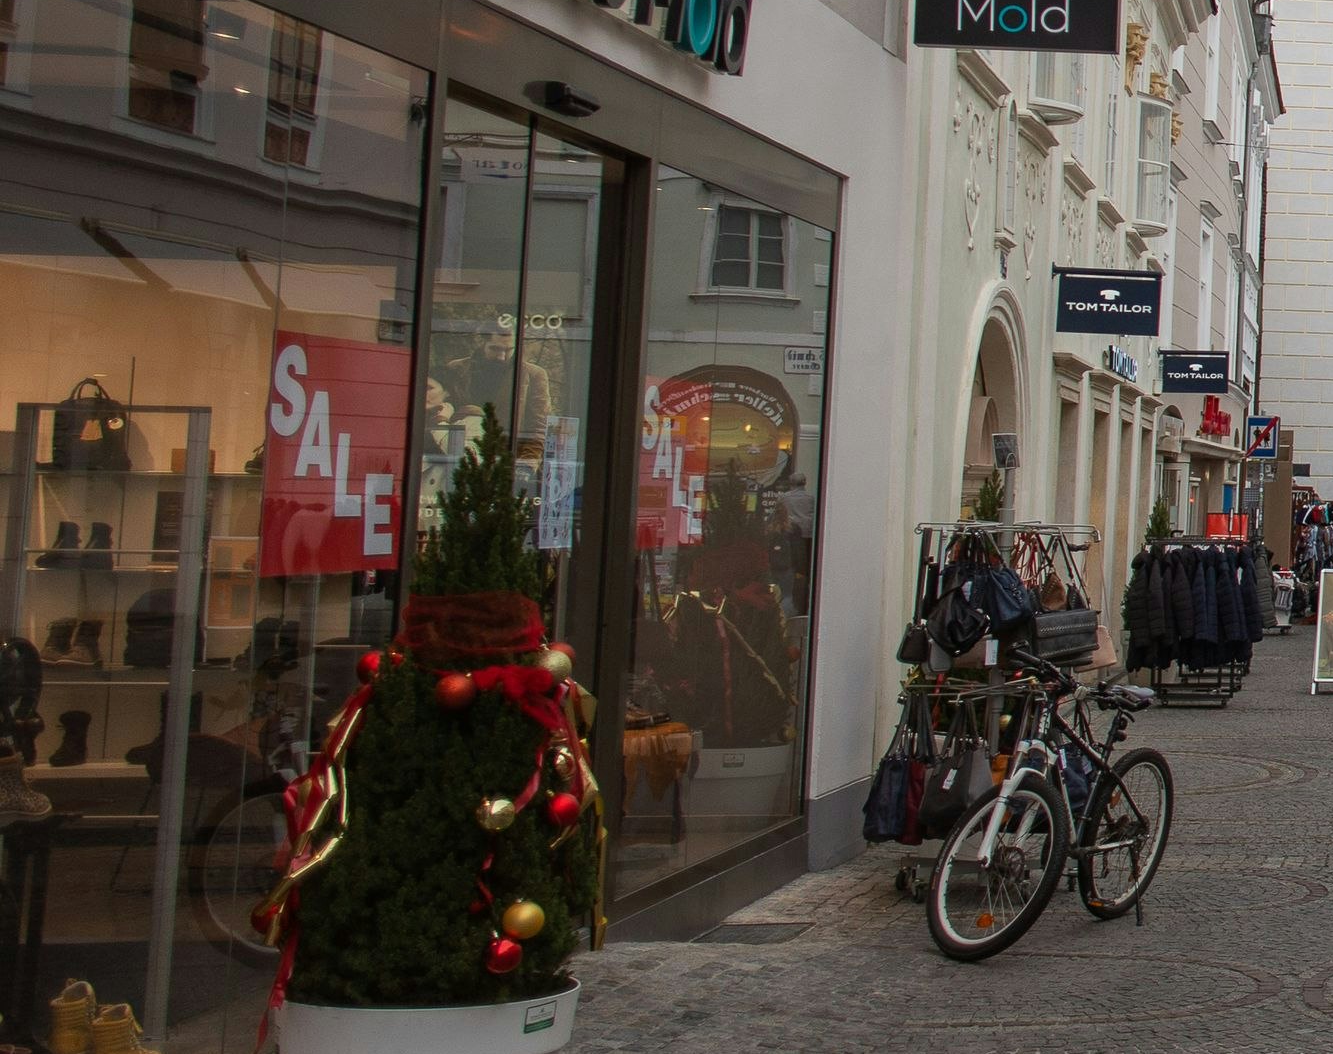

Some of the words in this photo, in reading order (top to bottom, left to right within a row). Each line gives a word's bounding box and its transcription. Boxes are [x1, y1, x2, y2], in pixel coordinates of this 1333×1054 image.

[497, 312, 562, 330] ecco
[1066, 301, 1099, 312] TOM
[1100, 303, 1152, 314] TAILOR
[270, 344, 394, 556] SALE
[641, 384, 705, 536] SALE
